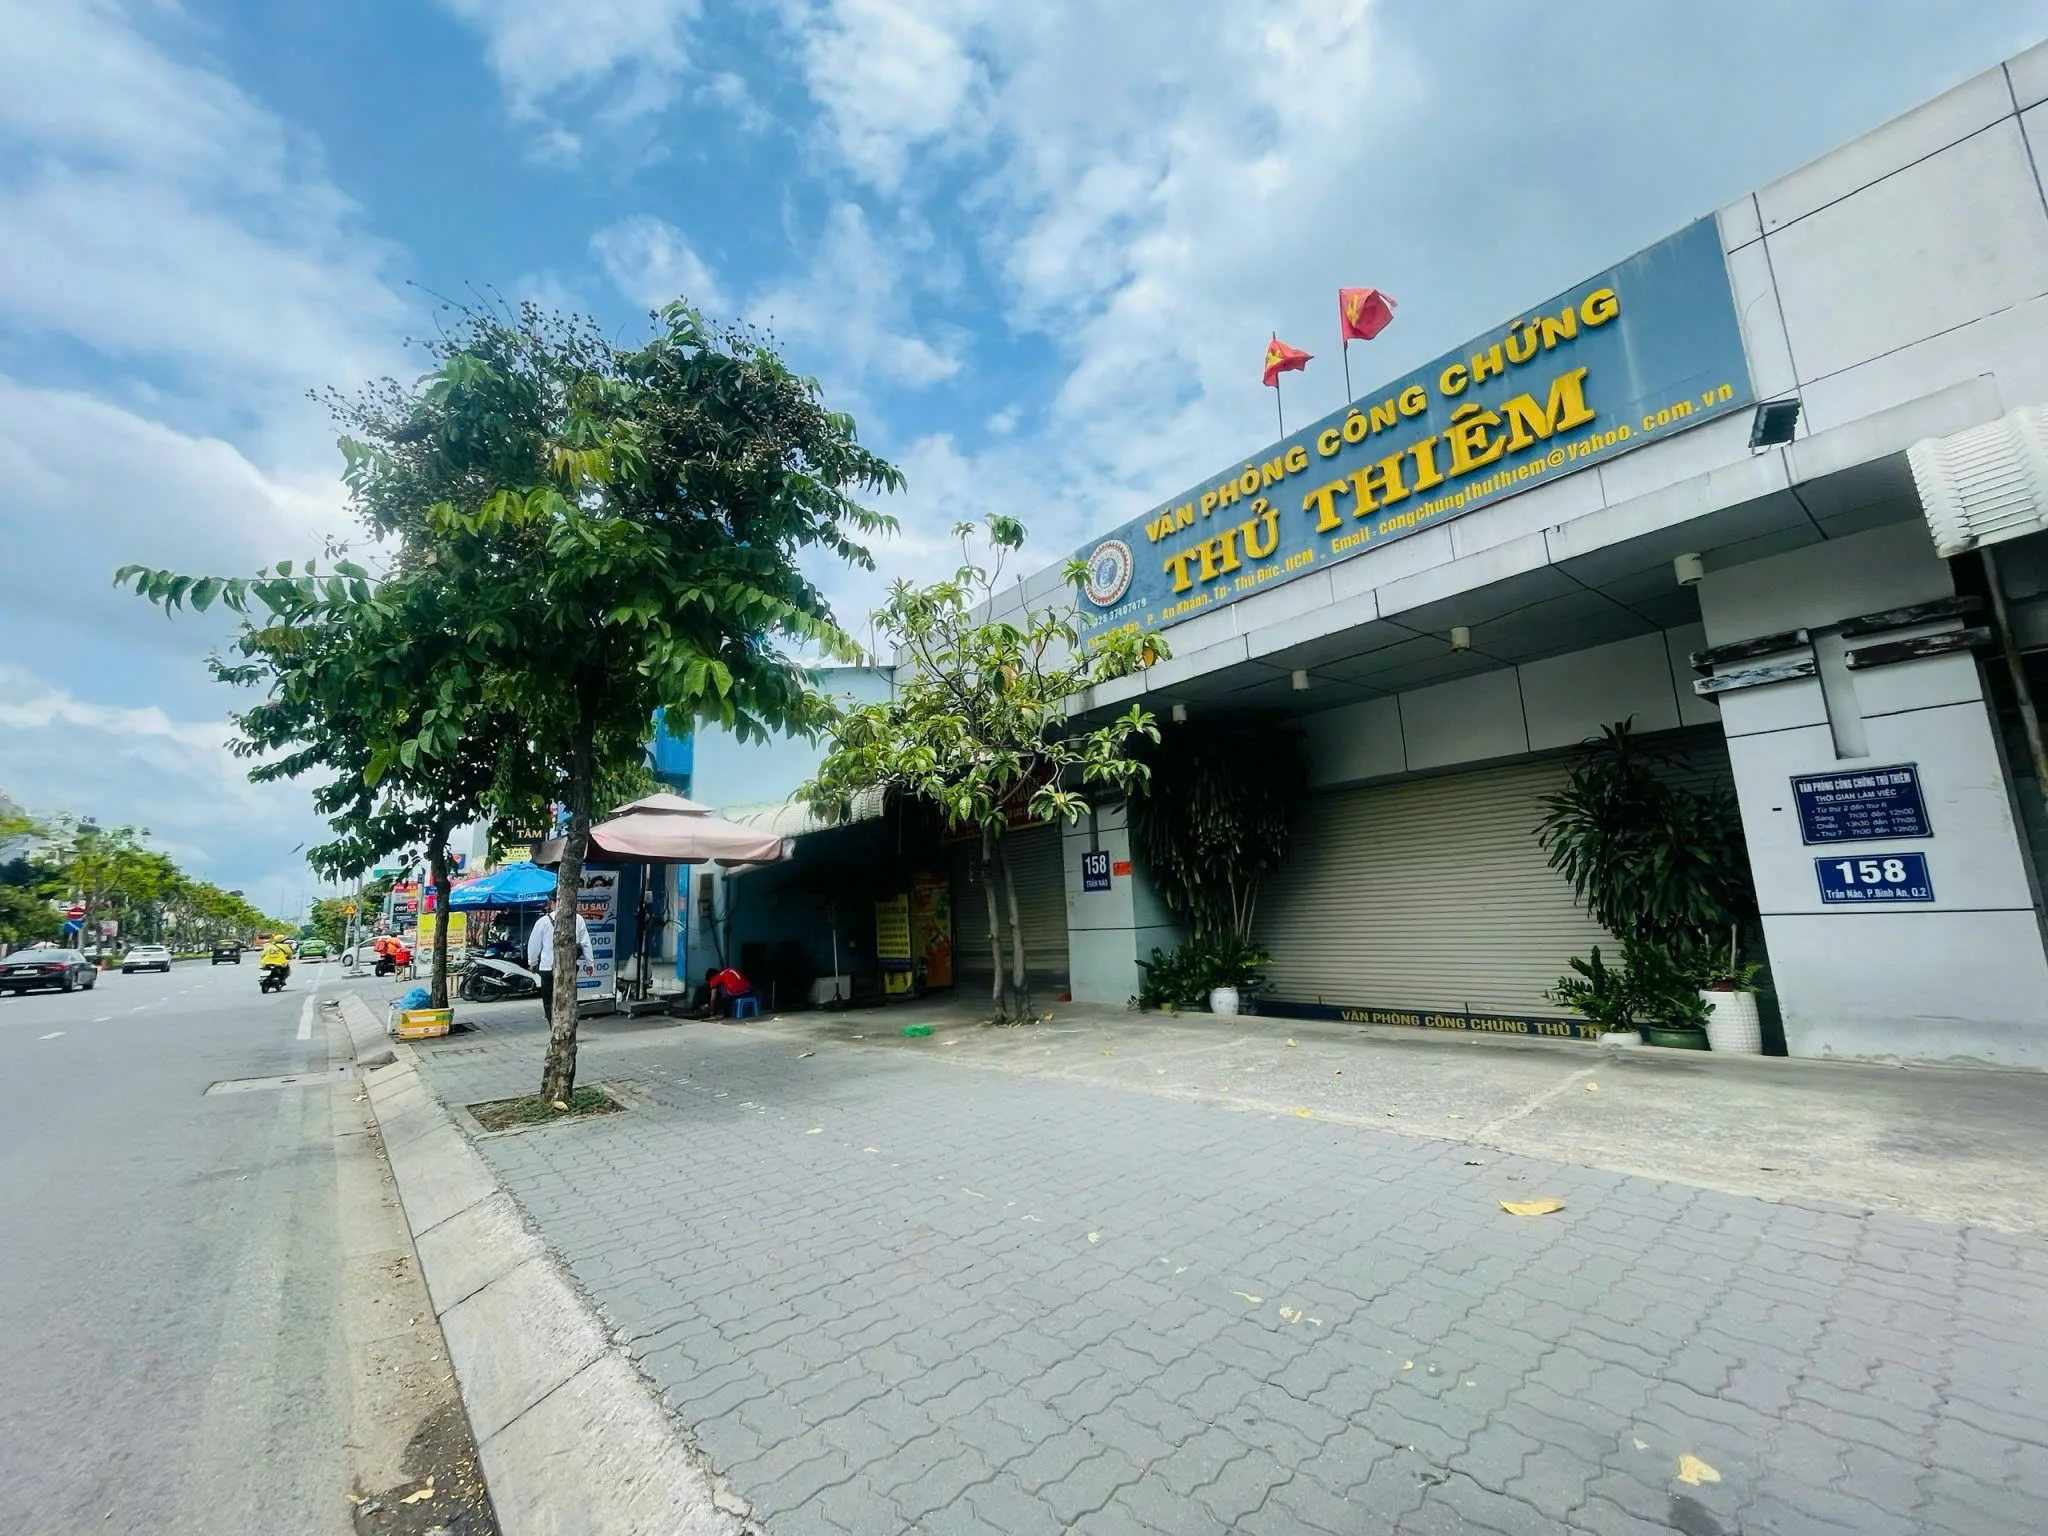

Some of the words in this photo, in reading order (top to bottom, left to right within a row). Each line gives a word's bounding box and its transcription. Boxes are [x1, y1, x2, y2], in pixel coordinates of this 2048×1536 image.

[1144, 502, 1195, 543] VĂN
[1200, 446, 1308, 517] PHÒNG
[1317, 385, 1427, 457] CÔNG
[1439, 288, 1620, 396] CHỨNG
[1163, 498, 1280, 594] THỦ
[1303, 366, 1596, 533] THIÊM
[1799, 781, 1813, 793] VĂN
[1813, 780, 1834, 792] PHÒNG
[1834, 778, 1852, 790] CÔNG
[1852, 776, 1876, 788] CHỨNG
[1875, 772, 1889, 786] THỦ
[1889, 771, 1911, 784] THIÊM
[1814, 794, 1834, 802] THỜI
[1835, 792, 1855, 801] GIAN
[1857, 789, 1875, 799] LÀM
[1877, 788, 1896, 797] VIỆC
[516, 829, 543, 839] TÂM
[1085, 854, 1107, 875] 158
[1835, 859, 1907, 884] 158
[1826, 889, 1845, 899] Trần
[1911, 887, 1927, 897] Q.2
[1341, 1010, 1369, 1022] VĂN
[1373, 1012, 1420, 1026] PHÒNG
[1424, 1014, 1466, 1029] CÔNG
[1470, 1017, 1528, 1033] CHỨNG
[1534, 1021, 1571, 1036] THỦ
